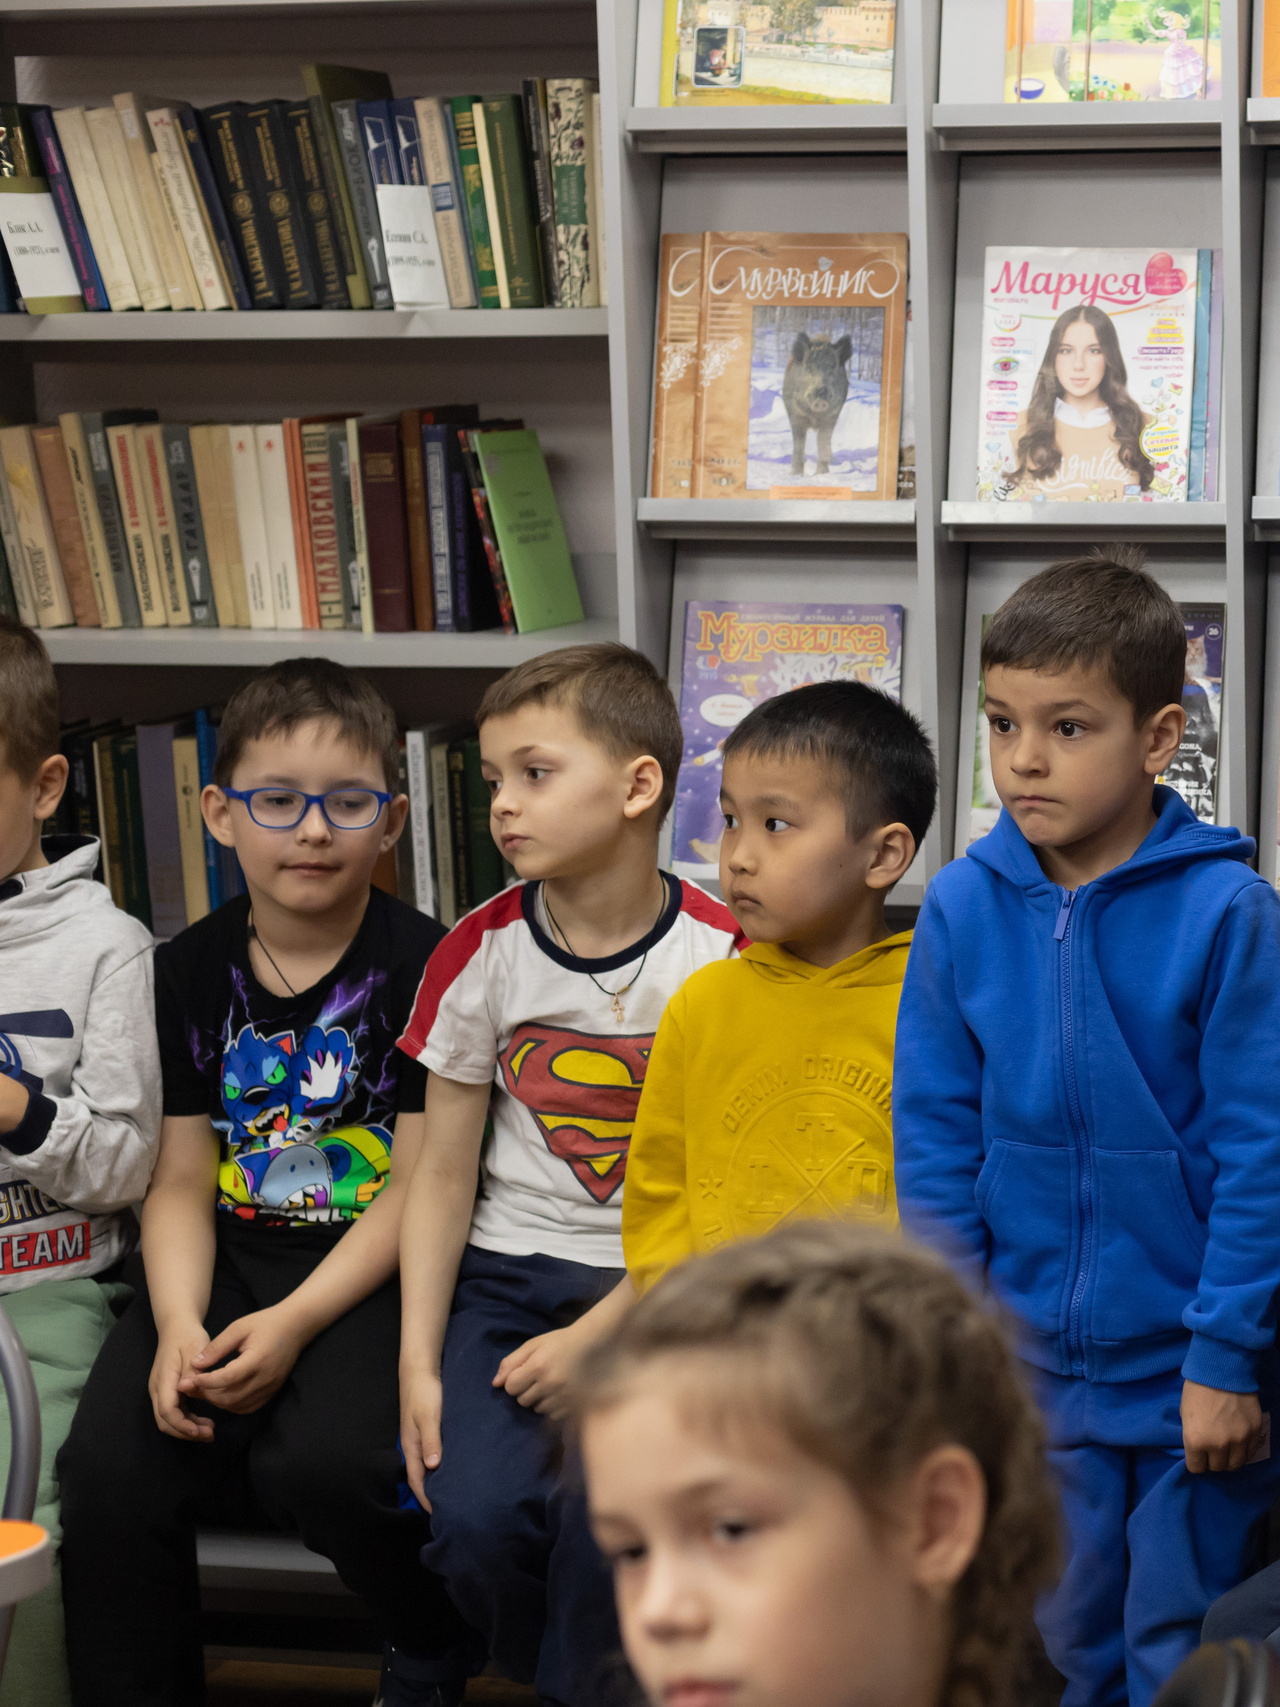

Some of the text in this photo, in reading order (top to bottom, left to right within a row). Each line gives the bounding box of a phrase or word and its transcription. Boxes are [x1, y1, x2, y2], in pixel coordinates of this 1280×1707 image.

[990, 260, 1147, 310] Маруся
[696, 611, 889, 663] Мурзилка
[721, 1061, 789, 1134] DENIM
